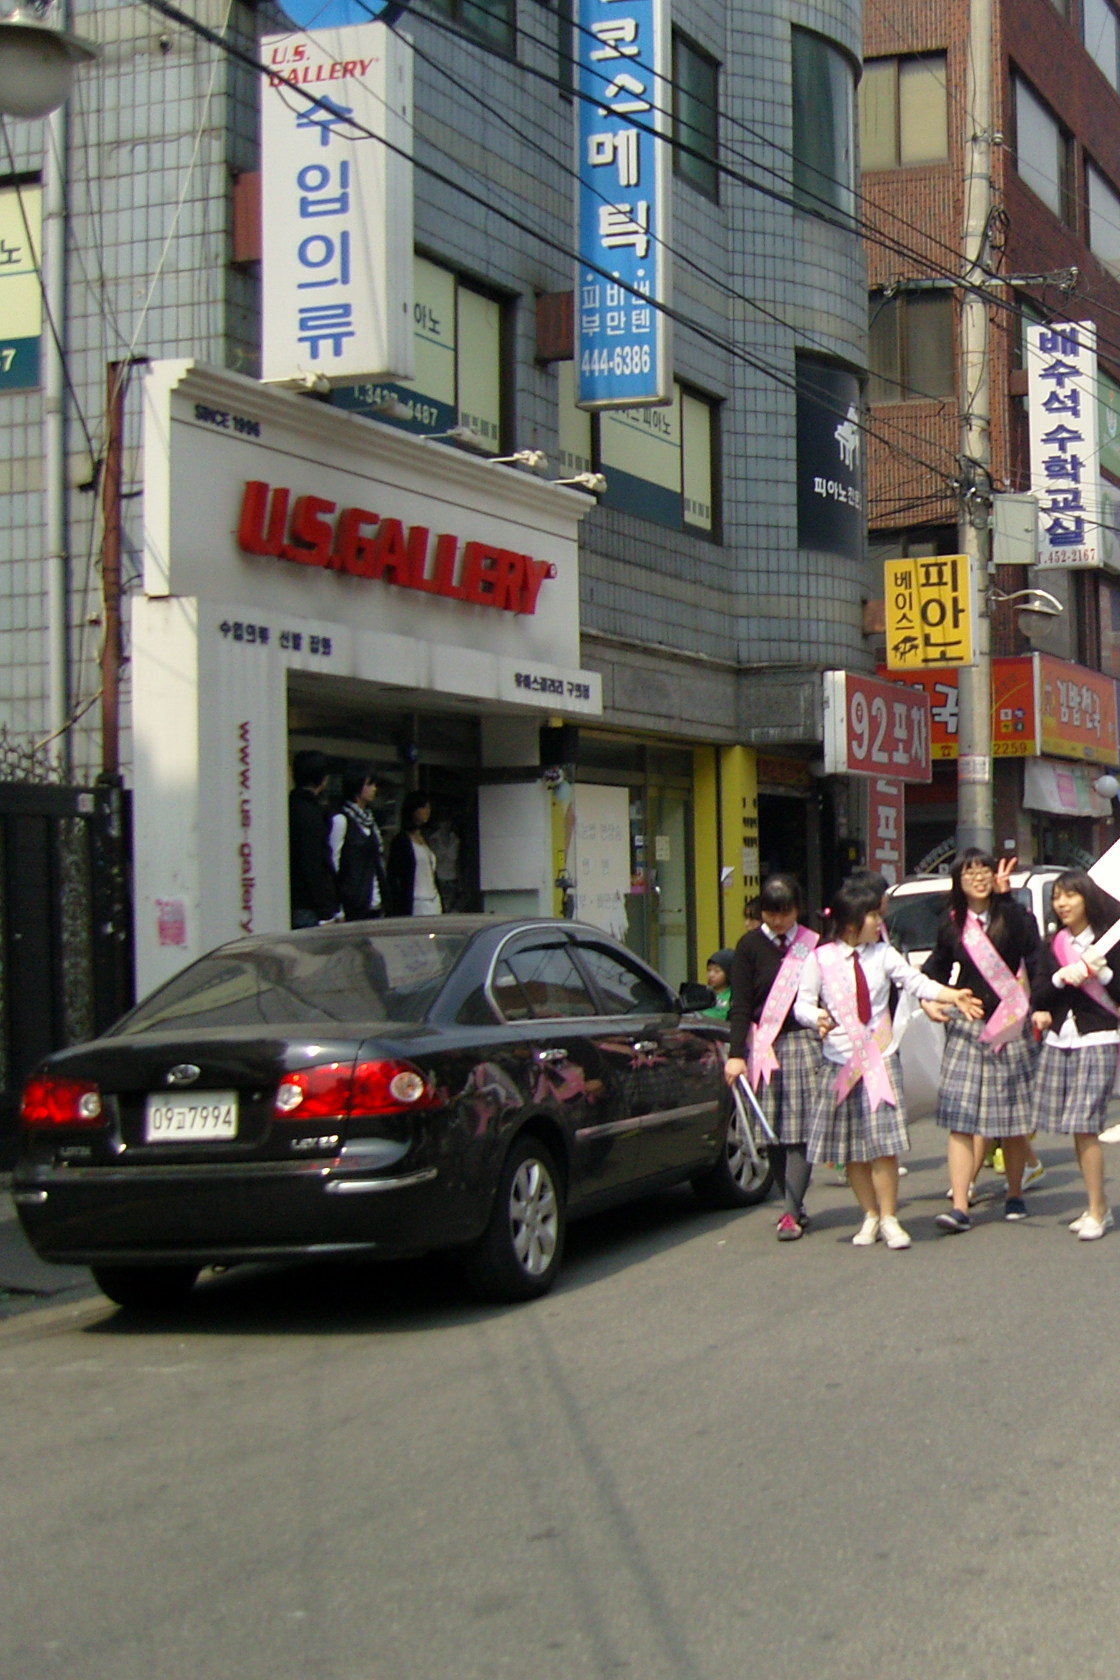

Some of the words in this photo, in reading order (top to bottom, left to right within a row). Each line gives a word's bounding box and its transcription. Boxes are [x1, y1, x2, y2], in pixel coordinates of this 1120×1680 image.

[268, 57, 374, 88] GALLERY
[270, 44, 311, 65] U.S.
[588, 17, 652, 258] 코스메틱
[295, 93, 356, 361] 수입의류
[581, 344, 651, 377] 444-6386
[894, 570, 915, 631] 베이스
[920, 559, 965, 663] 피아노
[851, 691, 928, 769] 92포차
